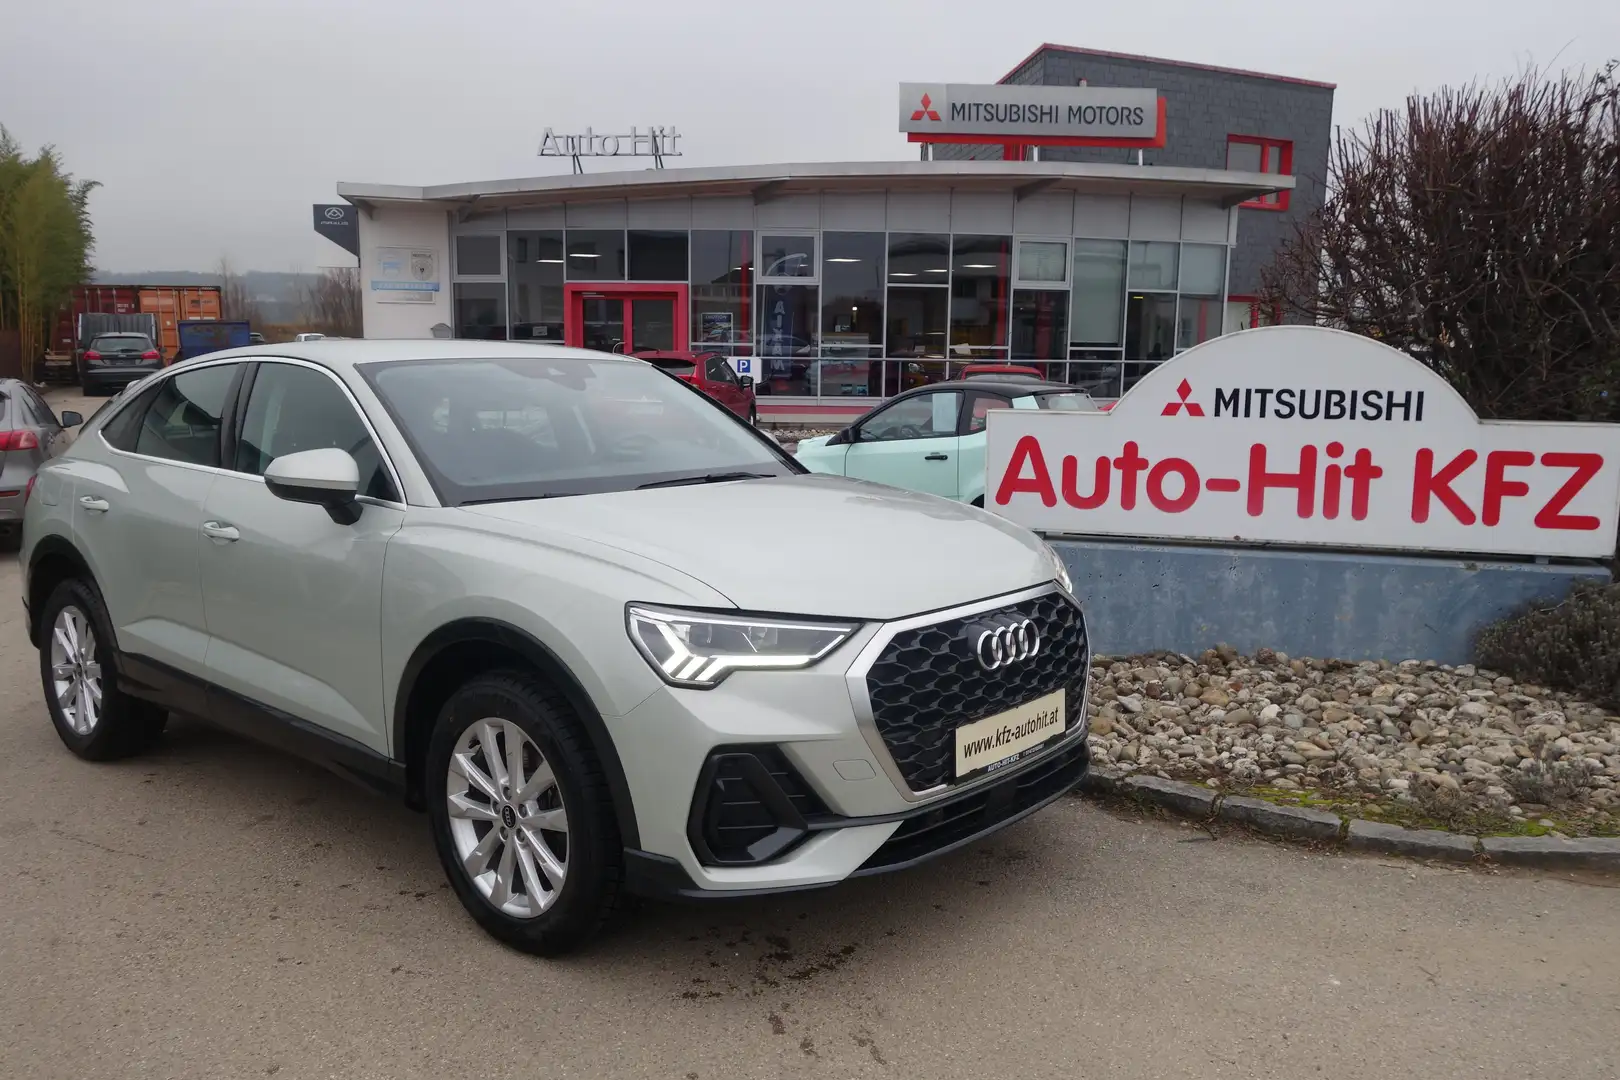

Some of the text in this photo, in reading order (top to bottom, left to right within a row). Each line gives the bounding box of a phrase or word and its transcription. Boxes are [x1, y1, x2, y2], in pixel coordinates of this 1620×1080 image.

[951, 102, 1144, 126] MITSUBISHI MOTORS
[537, 126, 682, 156] Auto Hit
[739, 361, 748, 372] P
[1214, 387, 1424, 422] MITSUBISHI
[995, 435, 1605, 531] Auto-Hit KFZ
[963, 706, 1059, 759] www.kfz-autohit.at
